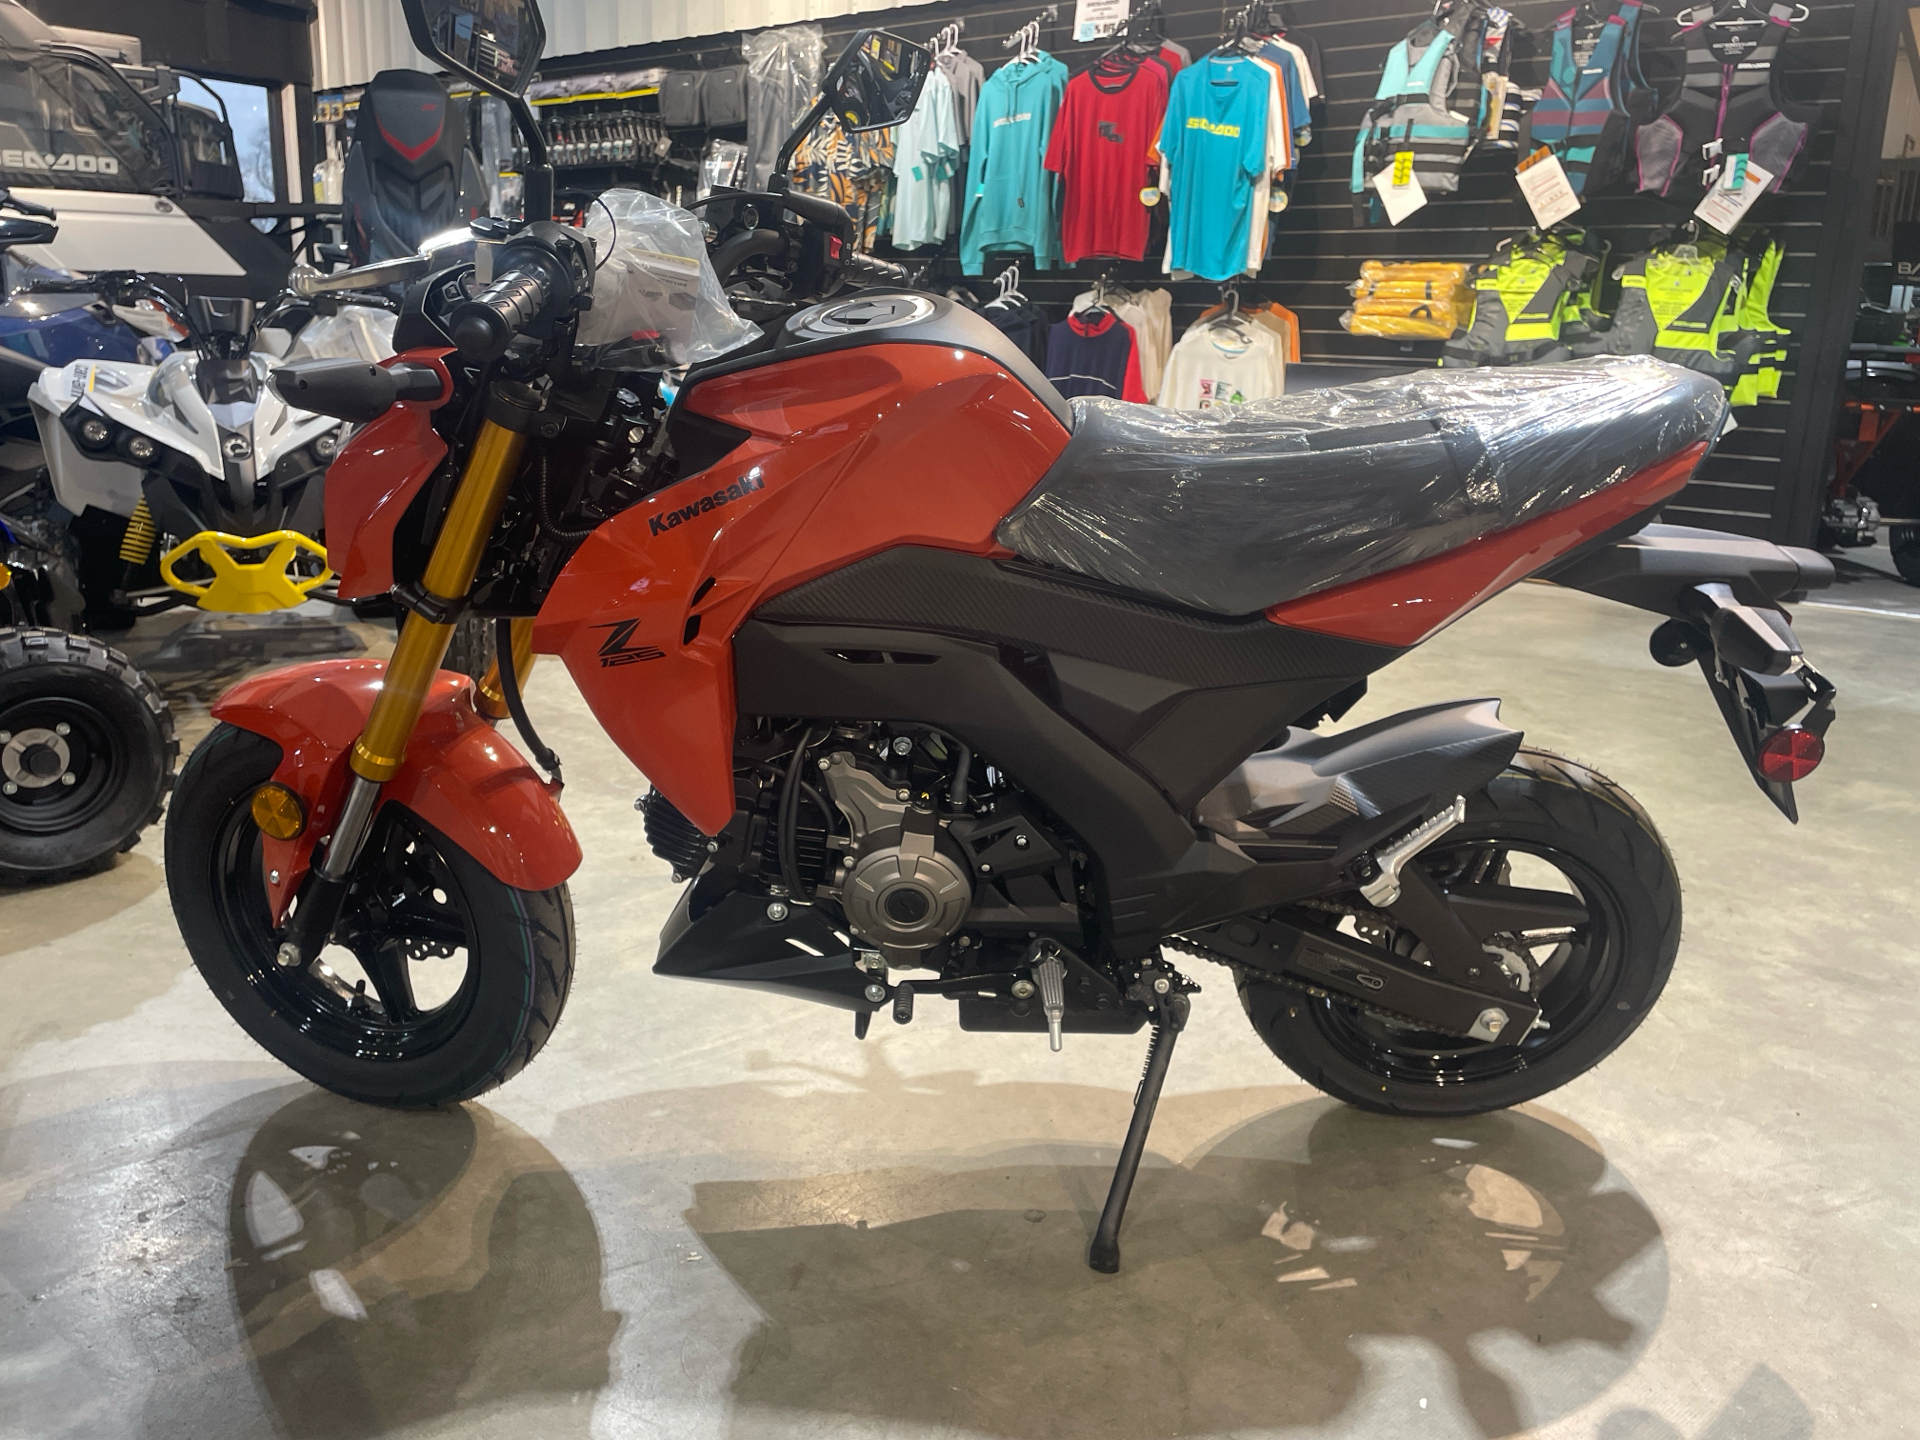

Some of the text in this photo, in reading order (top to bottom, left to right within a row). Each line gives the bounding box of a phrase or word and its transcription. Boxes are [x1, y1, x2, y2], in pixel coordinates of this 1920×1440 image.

[648, 475, 765, 536] Kawasaki
[587, 617, 659, 656] Z
[600, 650, 667, 668] 125
